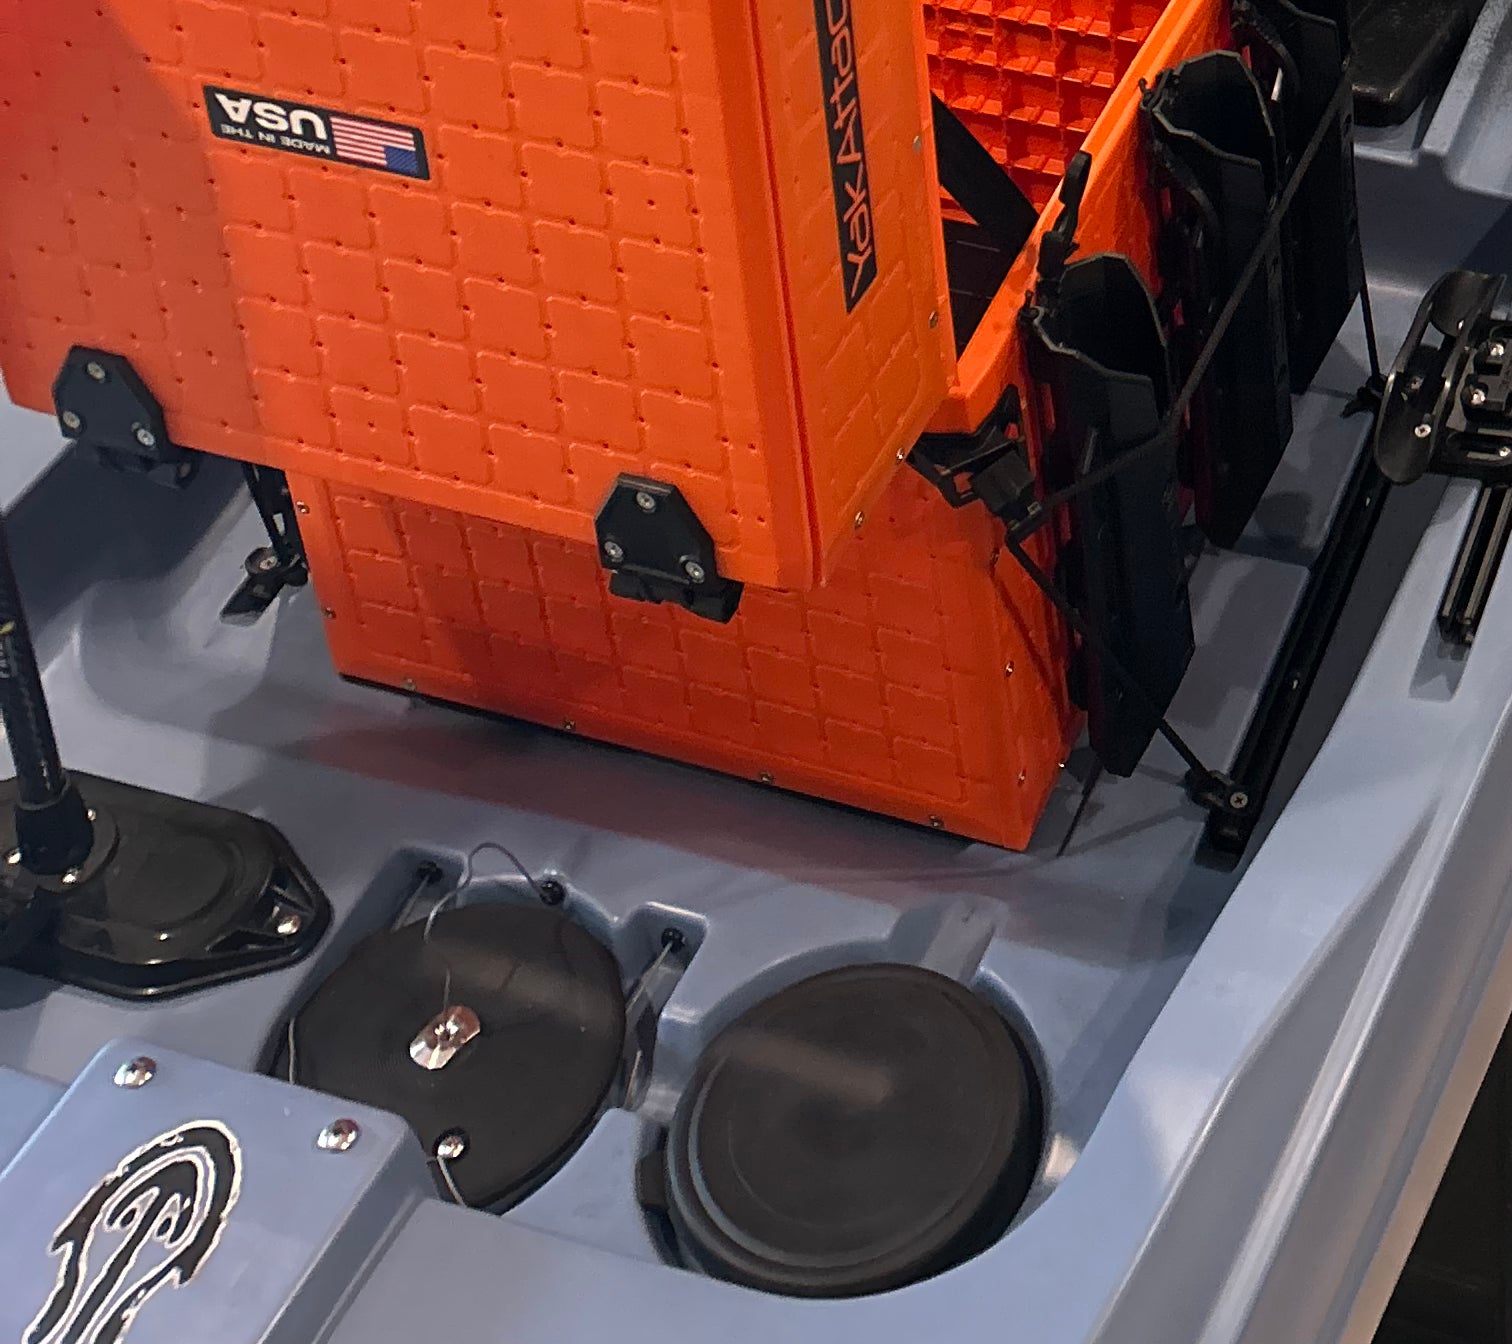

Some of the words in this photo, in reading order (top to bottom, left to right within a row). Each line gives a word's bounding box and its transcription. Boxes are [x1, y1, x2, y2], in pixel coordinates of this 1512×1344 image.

[214, 92, 328, 141] USA
[220, 123, 253, 140] THE
[258, 132, 276, 144] IN
[279, 135, 332, 155] MADE
